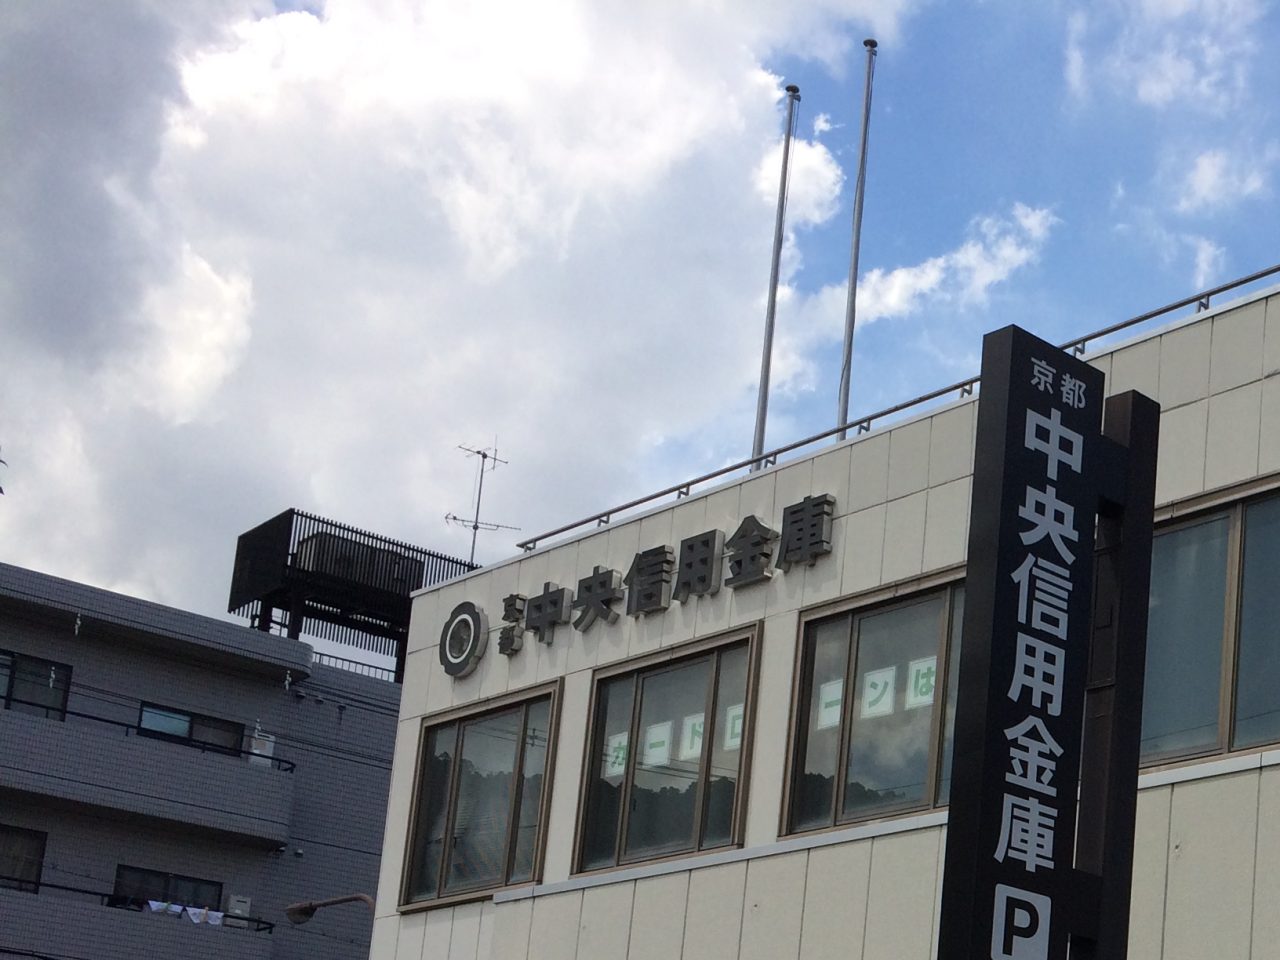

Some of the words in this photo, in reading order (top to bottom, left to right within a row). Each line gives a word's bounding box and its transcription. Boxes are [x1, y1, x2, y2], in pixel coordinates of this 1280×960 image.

[1030, 355, 1087, 409] 京都
[993, 408, 1085, 873] 中央信用金庫
